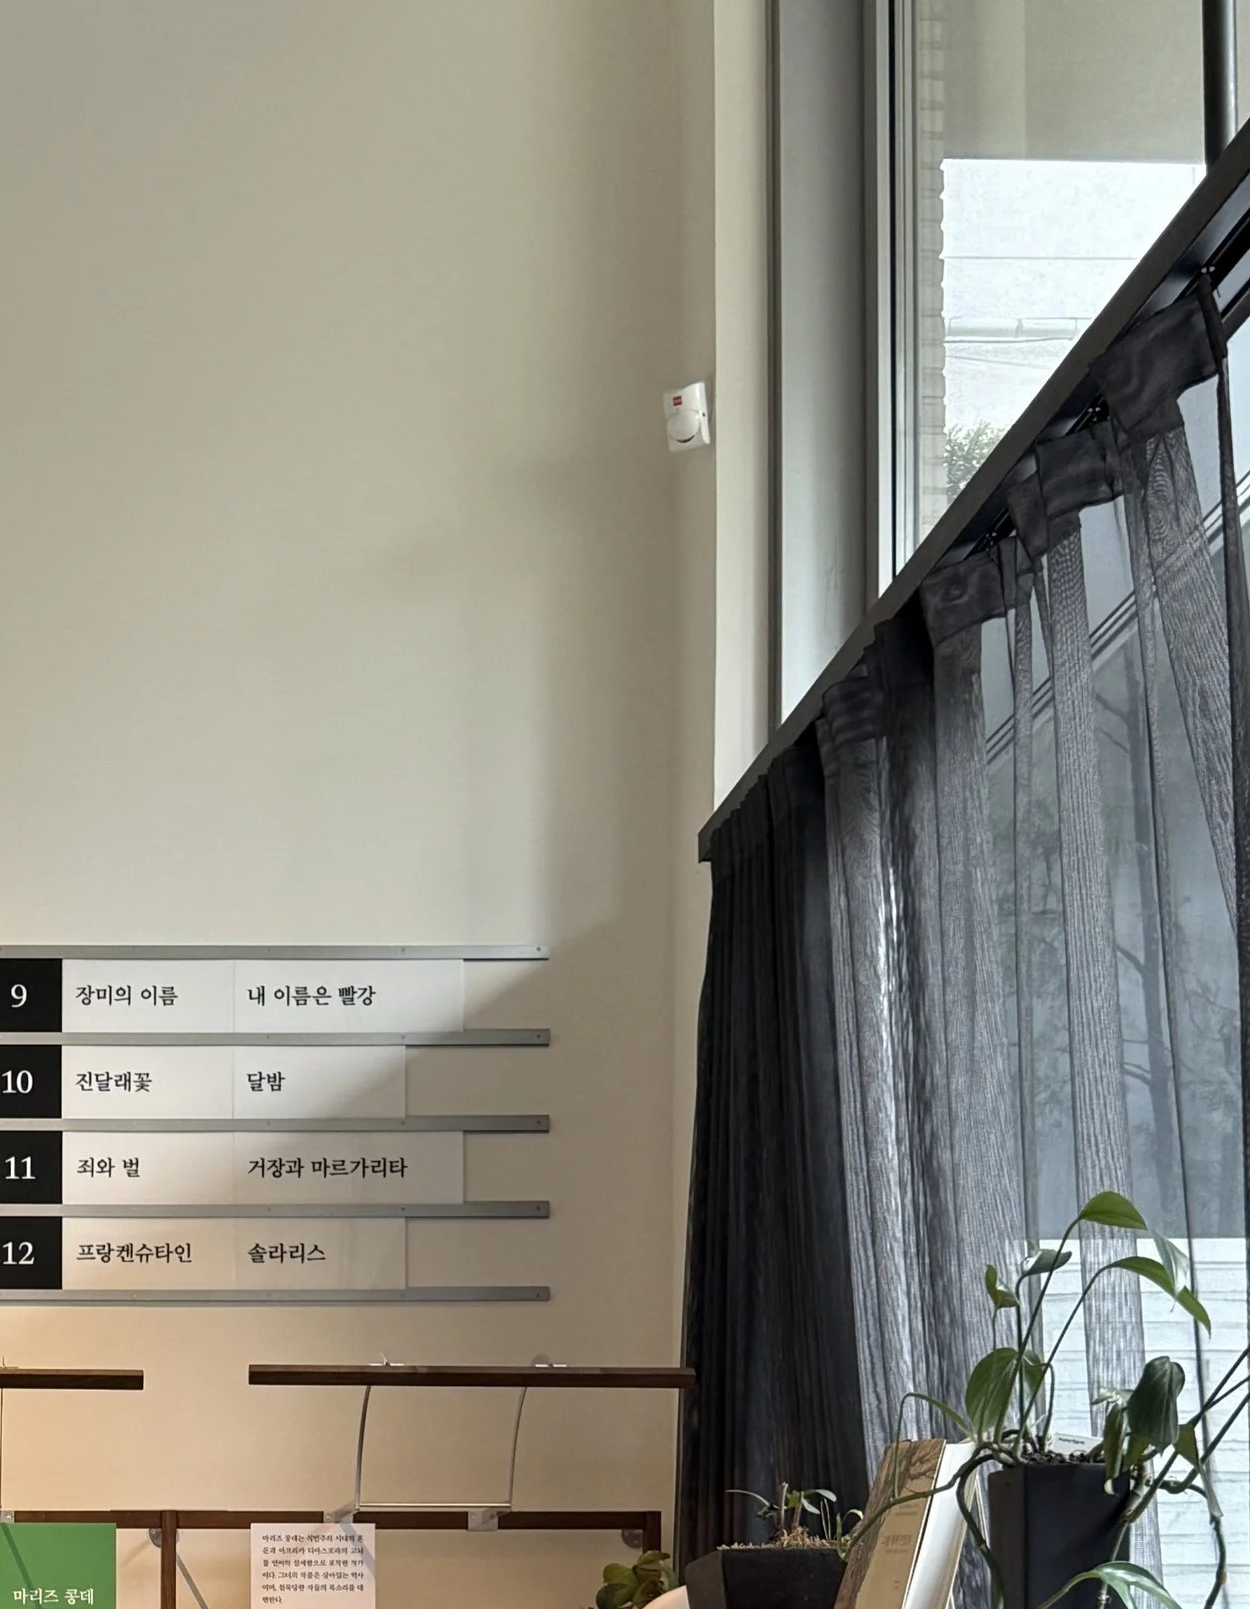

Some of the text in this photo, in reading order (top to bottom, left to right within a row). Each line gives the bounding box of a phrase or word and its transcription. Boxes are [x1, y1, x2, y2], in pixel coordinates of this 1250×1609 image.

[10, 984, 27, 1008] 9
[75, 984, 179, 1007] 장미의 이름
[247, 984, 377, 1007] 내 이름은 빨강
[2, 1070, 33, 1094] 10
[75, 1071, 153, 1093] 진달래꽃
[246, 1070, 286, 1093] 달밤
[5, 1156, 36, 1180] 11
[76, 1156, 141, 1179] 죄와 벌
[247, 1156, 409, 1179] 거장과 마르가리타
[2, 1241, 35, 1265] 12
[76, 1242, 192, 1264] 프랑켄슈타인
[247, 1242, 327, 1265] 솔라리스
[12, 1587, 95, 1606] 마리즈 콩데
